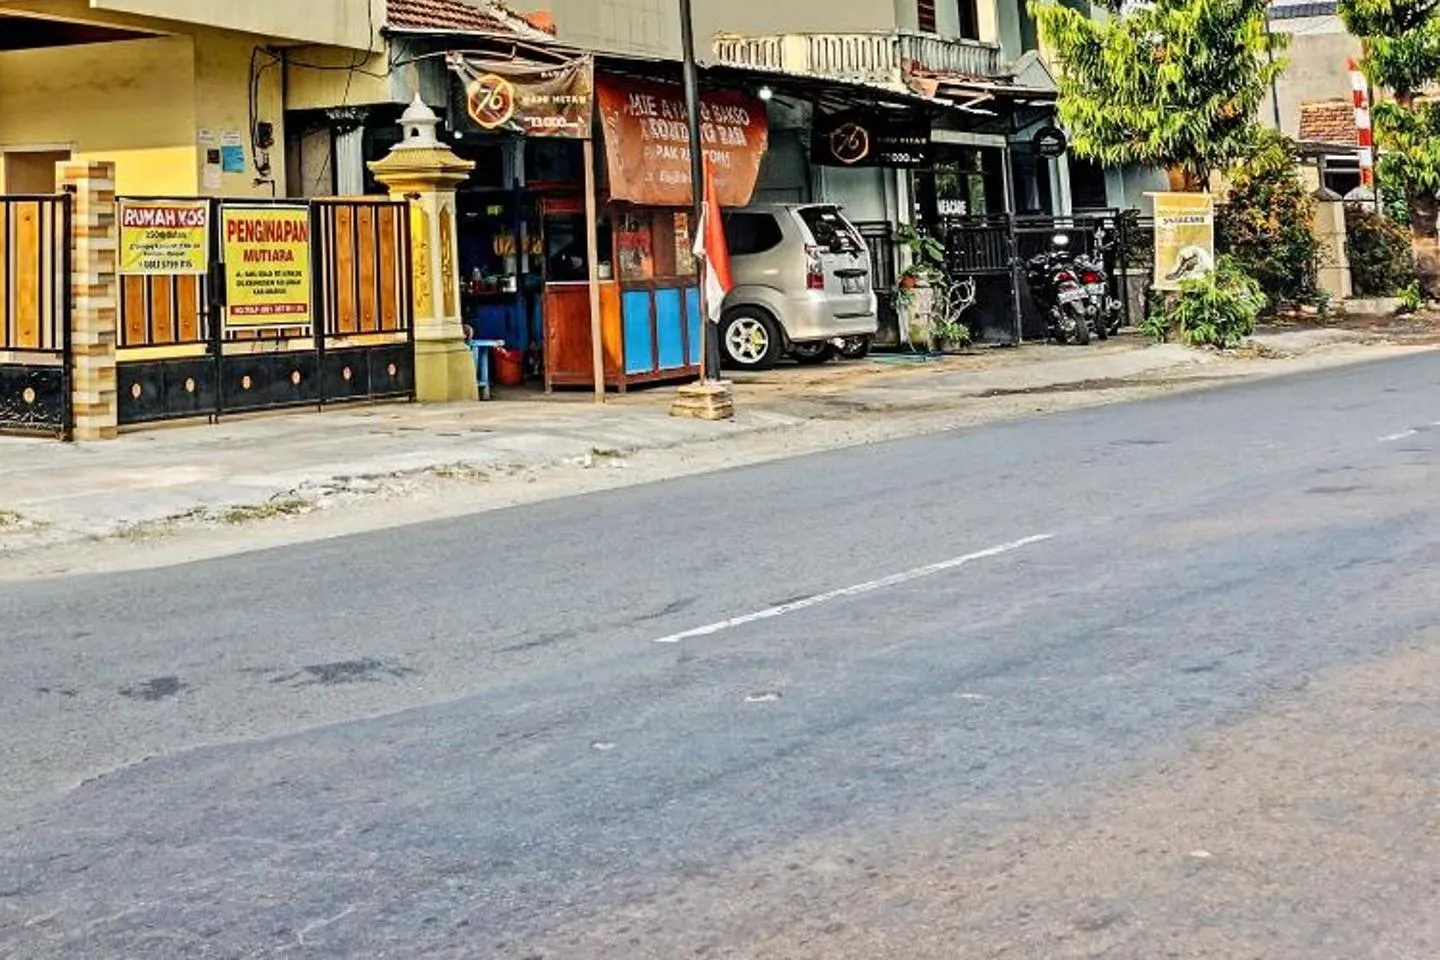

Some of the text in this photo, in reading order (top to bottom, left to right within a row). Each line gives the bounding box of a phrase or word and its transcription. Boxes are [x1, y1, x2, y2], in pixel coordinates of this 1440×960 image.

[661, 99, 689, 120] AYA
[124, 208, 205, 226] RUMAH KOS
[227, 219, 308, 242] PENGINAPAN
[243, 249, 294, 262] MUTIARA
